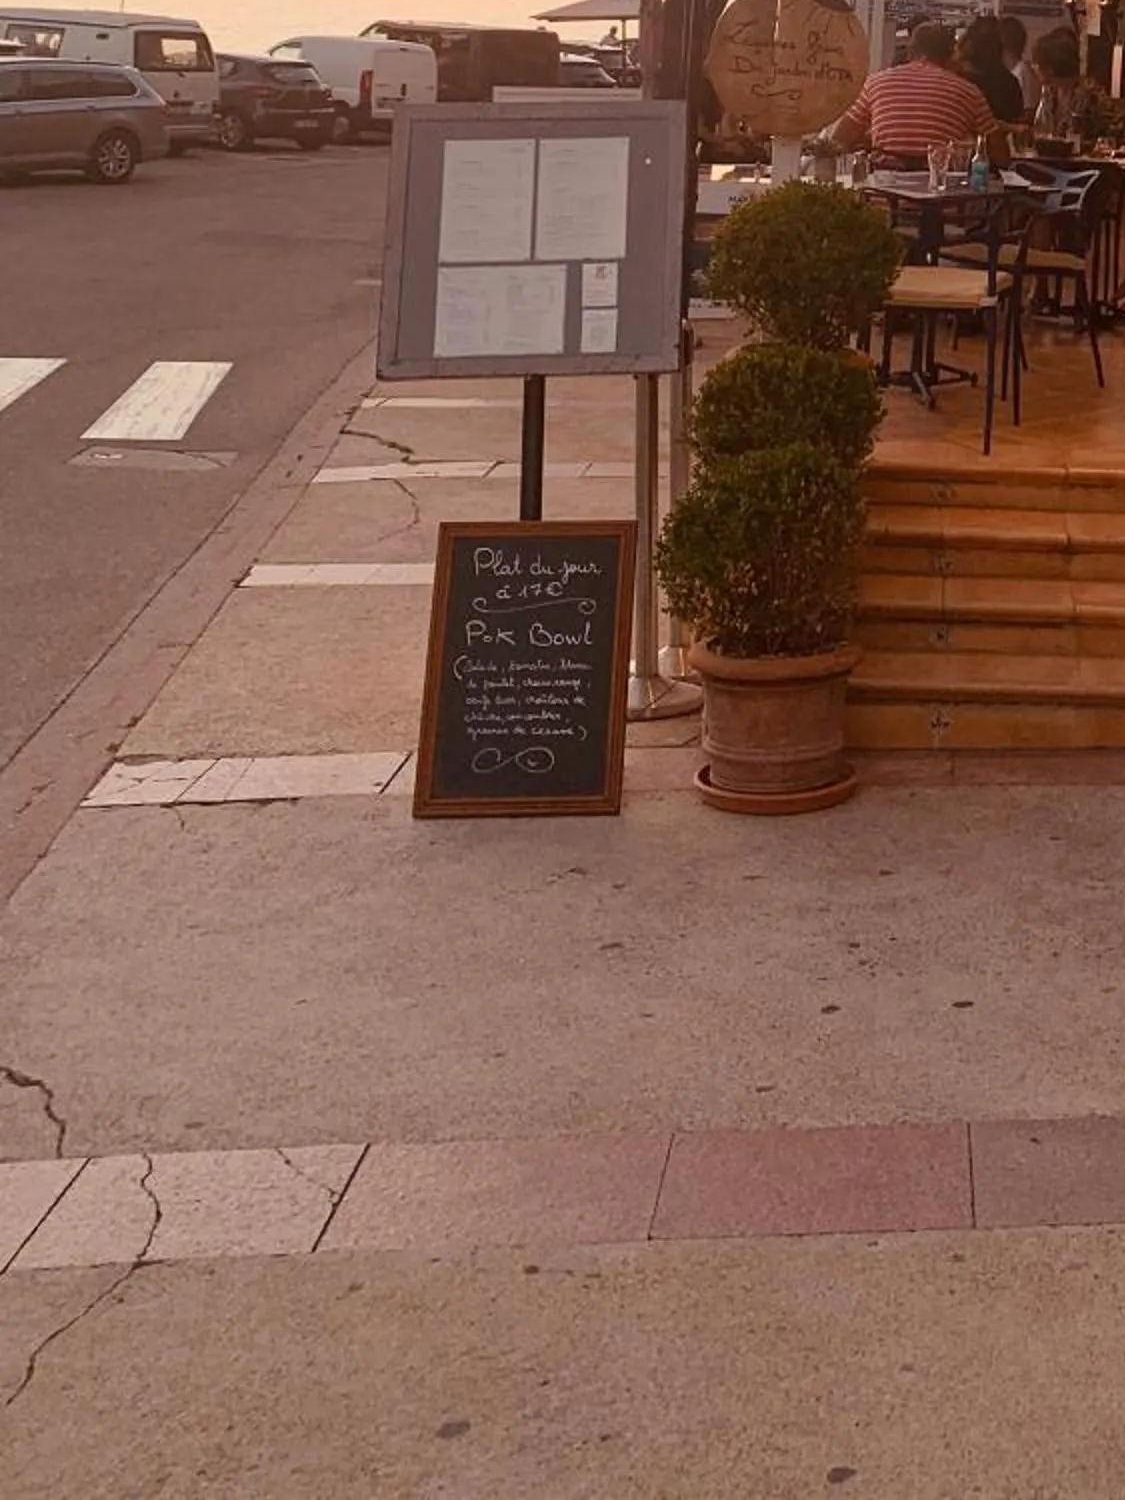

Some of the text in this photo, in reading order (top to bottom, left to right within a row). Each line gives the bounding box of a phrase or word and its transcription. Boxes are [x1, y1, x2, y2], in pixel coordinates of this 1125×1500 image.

[474, 547, 603, 584] Plat du jour
[529, 621, 593, 647] Bowl
